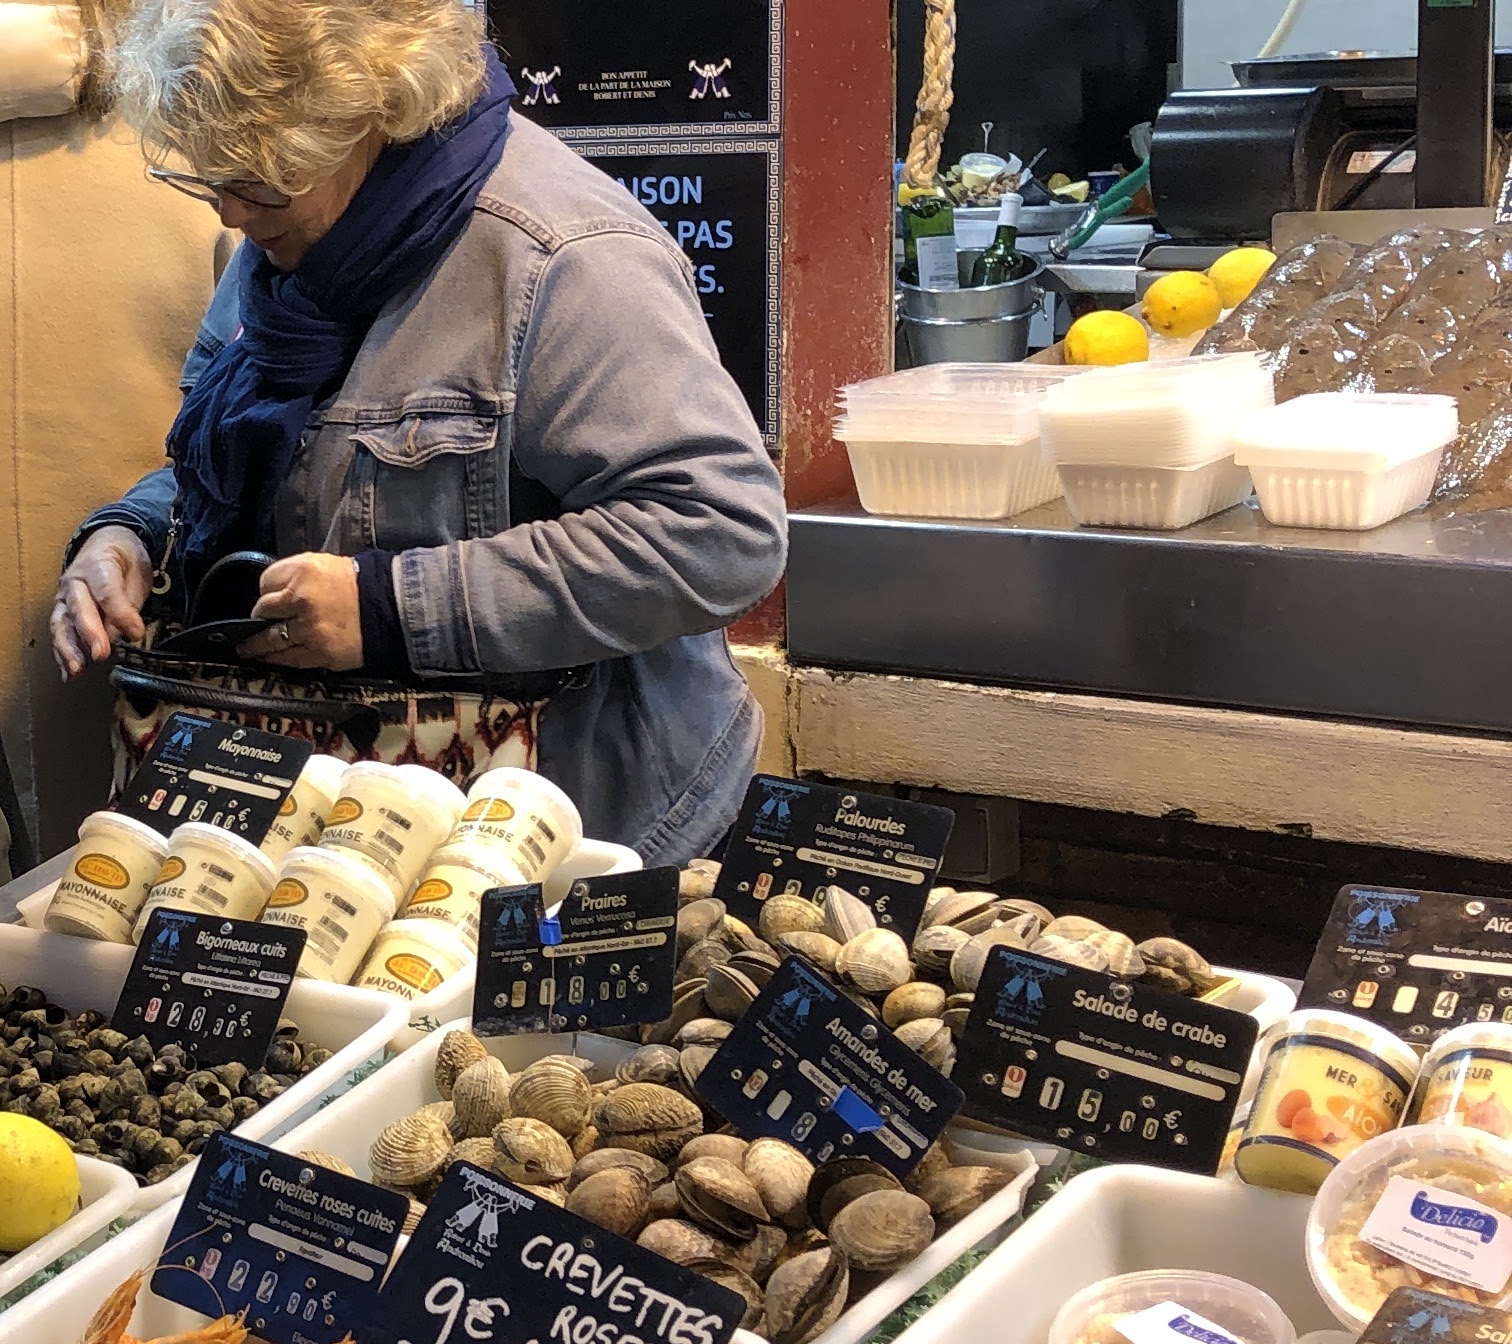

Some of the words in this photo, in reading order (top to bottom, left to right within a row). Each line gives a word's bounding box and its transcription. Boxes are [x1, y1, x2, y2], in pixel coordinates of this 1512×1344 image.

[678, 219, 733, 249] PAS
[218, 737, 282, 763] Mayonnaise
[835, 807, 907, 836] Palourdes
[581, 893, 627, 912] Praires
[196, 930, 259, 954] Bigorneaux
[260, 941, 288, 958] cuits
[1072, 989, 1138, 1024] Salade
[1142, 1010, 1168, 1032] de
[1171, 1019, 1227, 1049] crabe
[825, 1017, 890, 1076] Amandes
[887, 1066, 908, 1093] de
[906, 1086, 938, 1113] mer
[1326, 1064, 1359, 1088] MER
[259, 1169, 319, 1206] Crevettes
[321, 1194, 355, 1218] roses
[357, 1207, 396, 1234] cuites
